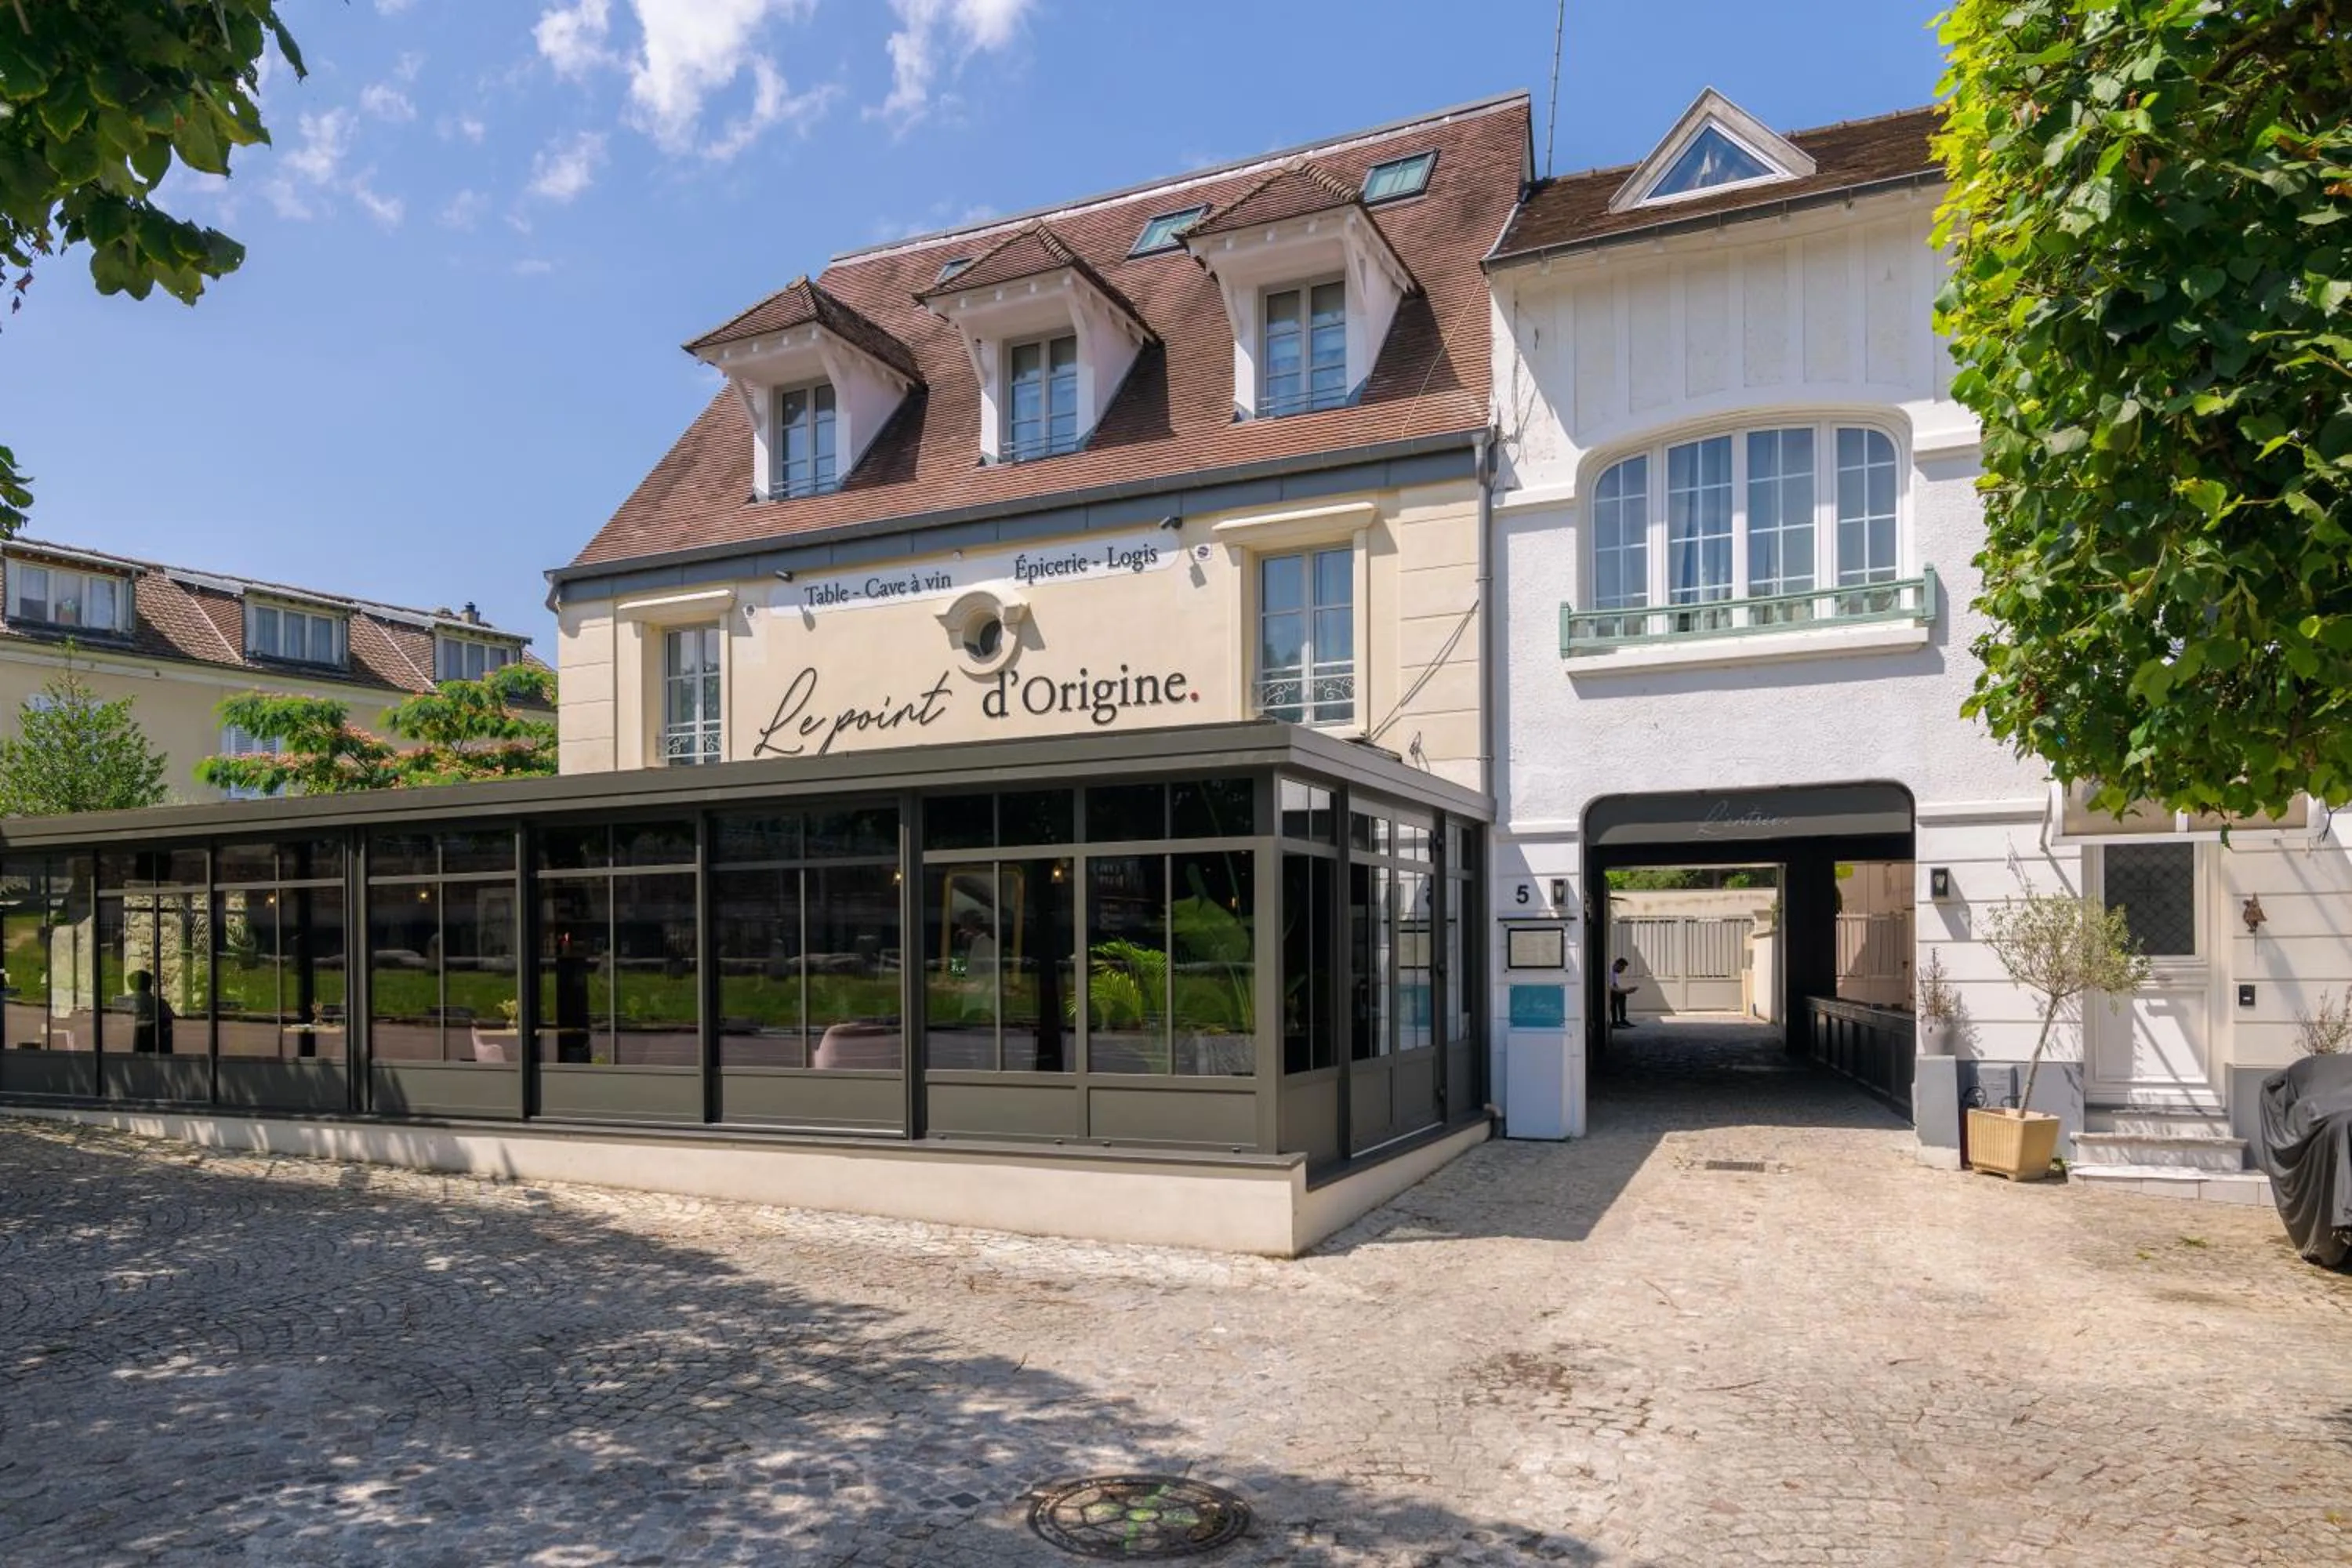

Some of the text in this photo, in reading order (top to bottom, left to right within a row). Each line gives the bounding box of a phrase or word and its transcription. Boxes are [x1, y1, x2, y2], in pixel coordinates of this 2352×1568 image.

[1014, 554, 1088, 585] Épicerie
[1107, 543, 1158, 574] Logis
[804, 583, 849, 606] Table
[865, 578, 906, 598] Cave
[910, 573, 920, 592] à
[925, 571, 952, 590] vin
[753, 663, 1200, 757] Le point d'Origine.
[1515, 884, 1530, 904] 5
